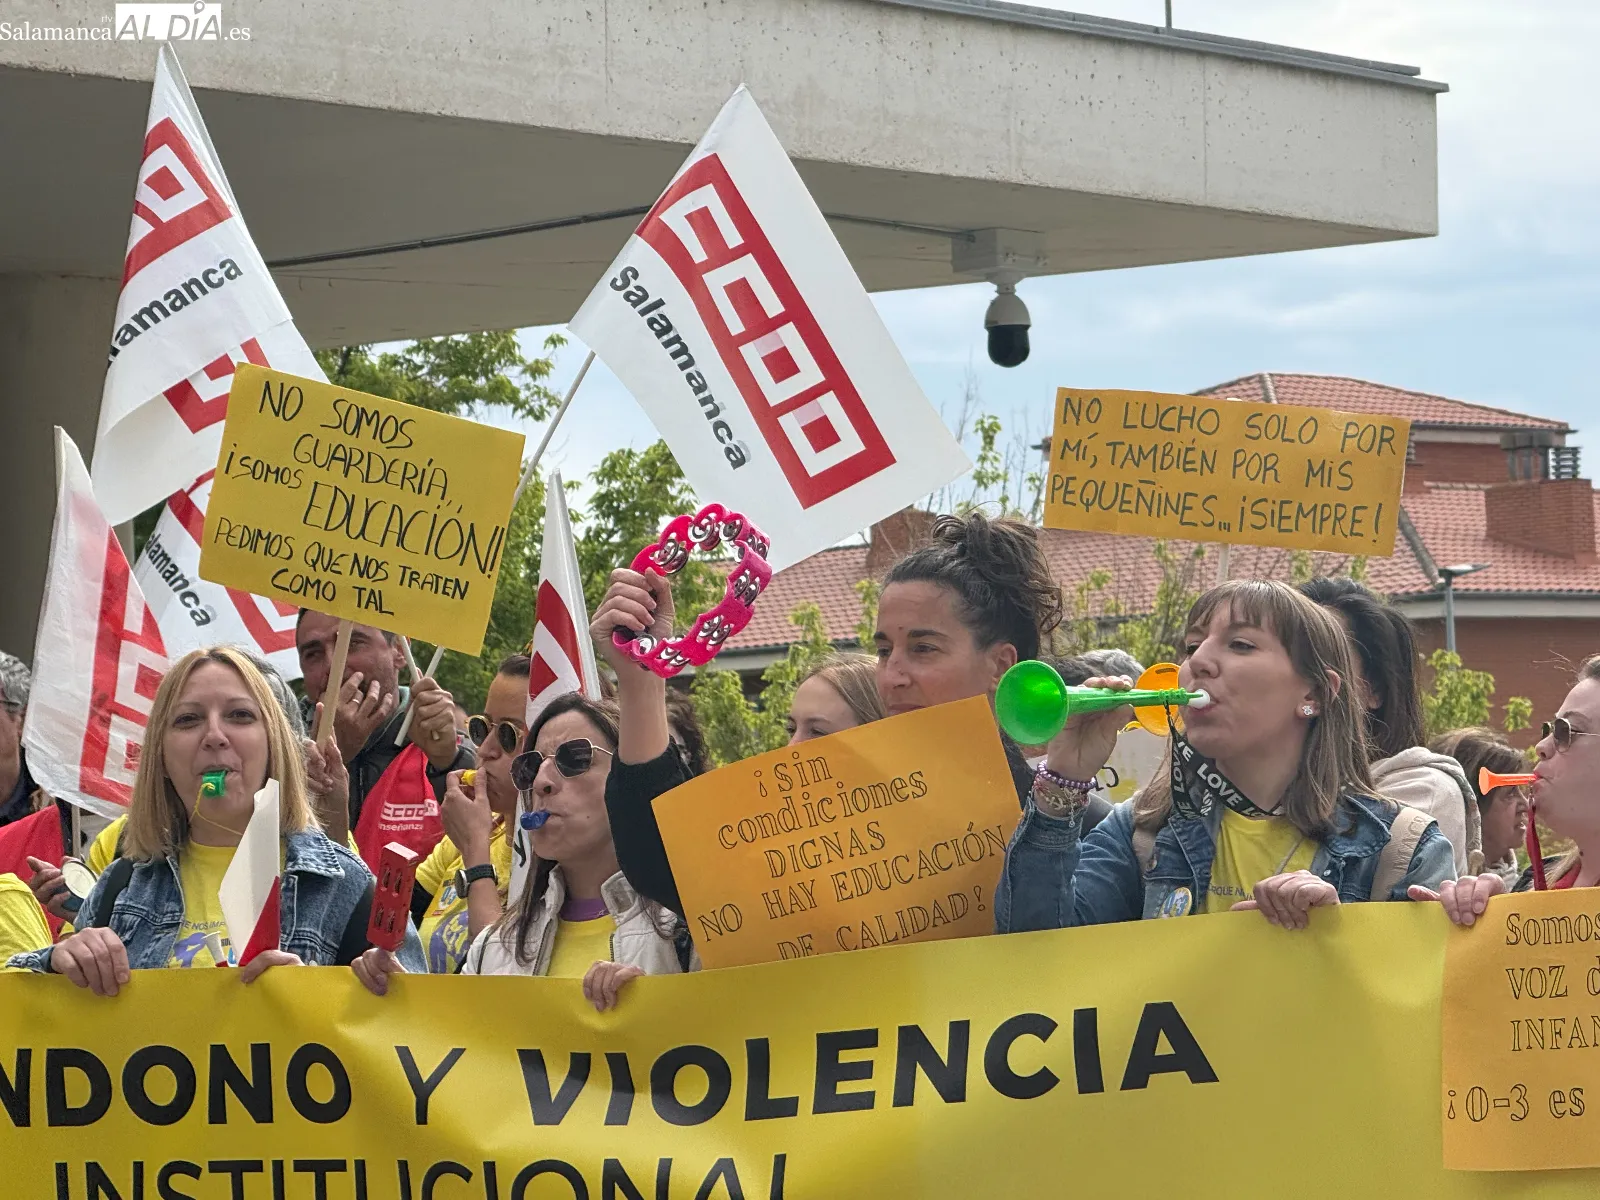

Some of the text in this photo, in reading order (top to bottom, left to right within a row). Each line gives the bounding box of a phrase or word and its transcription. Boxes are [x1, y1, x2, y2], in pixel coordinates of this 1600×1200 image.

[659, 183, 867, 478] CCOO
[609, 265, 749, 470] Salamanca
[258, 380, 417, 449] NO SOMOS
[1062, 397, 1396, 456] NO LUCHO SOLO POR
[1232, 448, 1282, 485] POR
[214, 516, 471, 601] PEDIMOS QUE NOS TRATEN
[270, 568, 395, 616] COMO TAL
[717, 770, 928, 850] condiciones
[1196, 762, 1243, 807] LOVE
[697, 821, 1007, 942] NO HAY EDUCACIÓN
[763, 821, 886, 878] DIGNAS
[777, 885, 986, 961] DE CALIDAD!
[1506, 965, 1569, 1000] VOZ
[395, 1045, 467, 1125] Y
[516, 1001, 1220, 1126] VIOLENCIA
[1549, 1087, 1586, 1119] es
